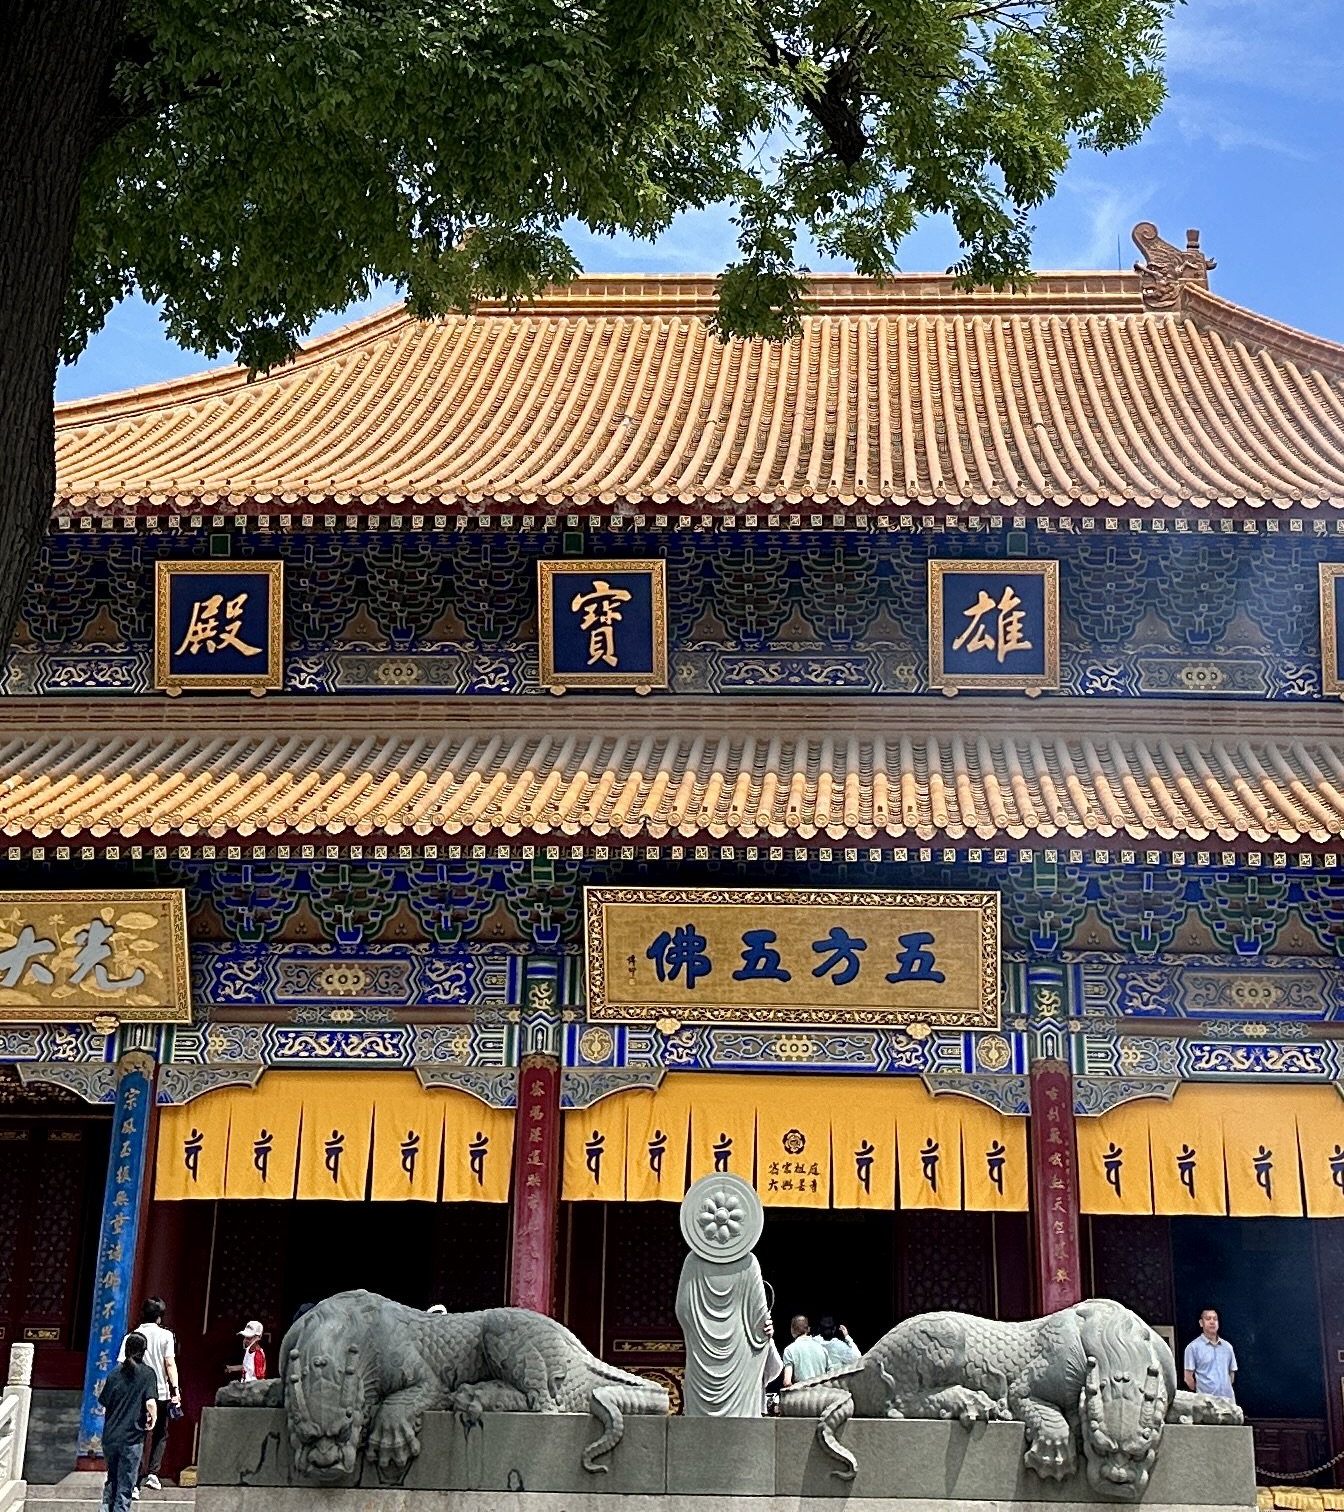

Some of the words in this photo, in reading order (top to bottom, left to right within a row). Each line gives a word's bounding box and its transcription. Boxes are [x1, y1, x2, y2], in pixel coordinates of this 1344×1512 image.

[174, 592, 263, 659] 殿
[570, 579, 632, 669] 寶
[952, 586, 1035, 664] 雄
